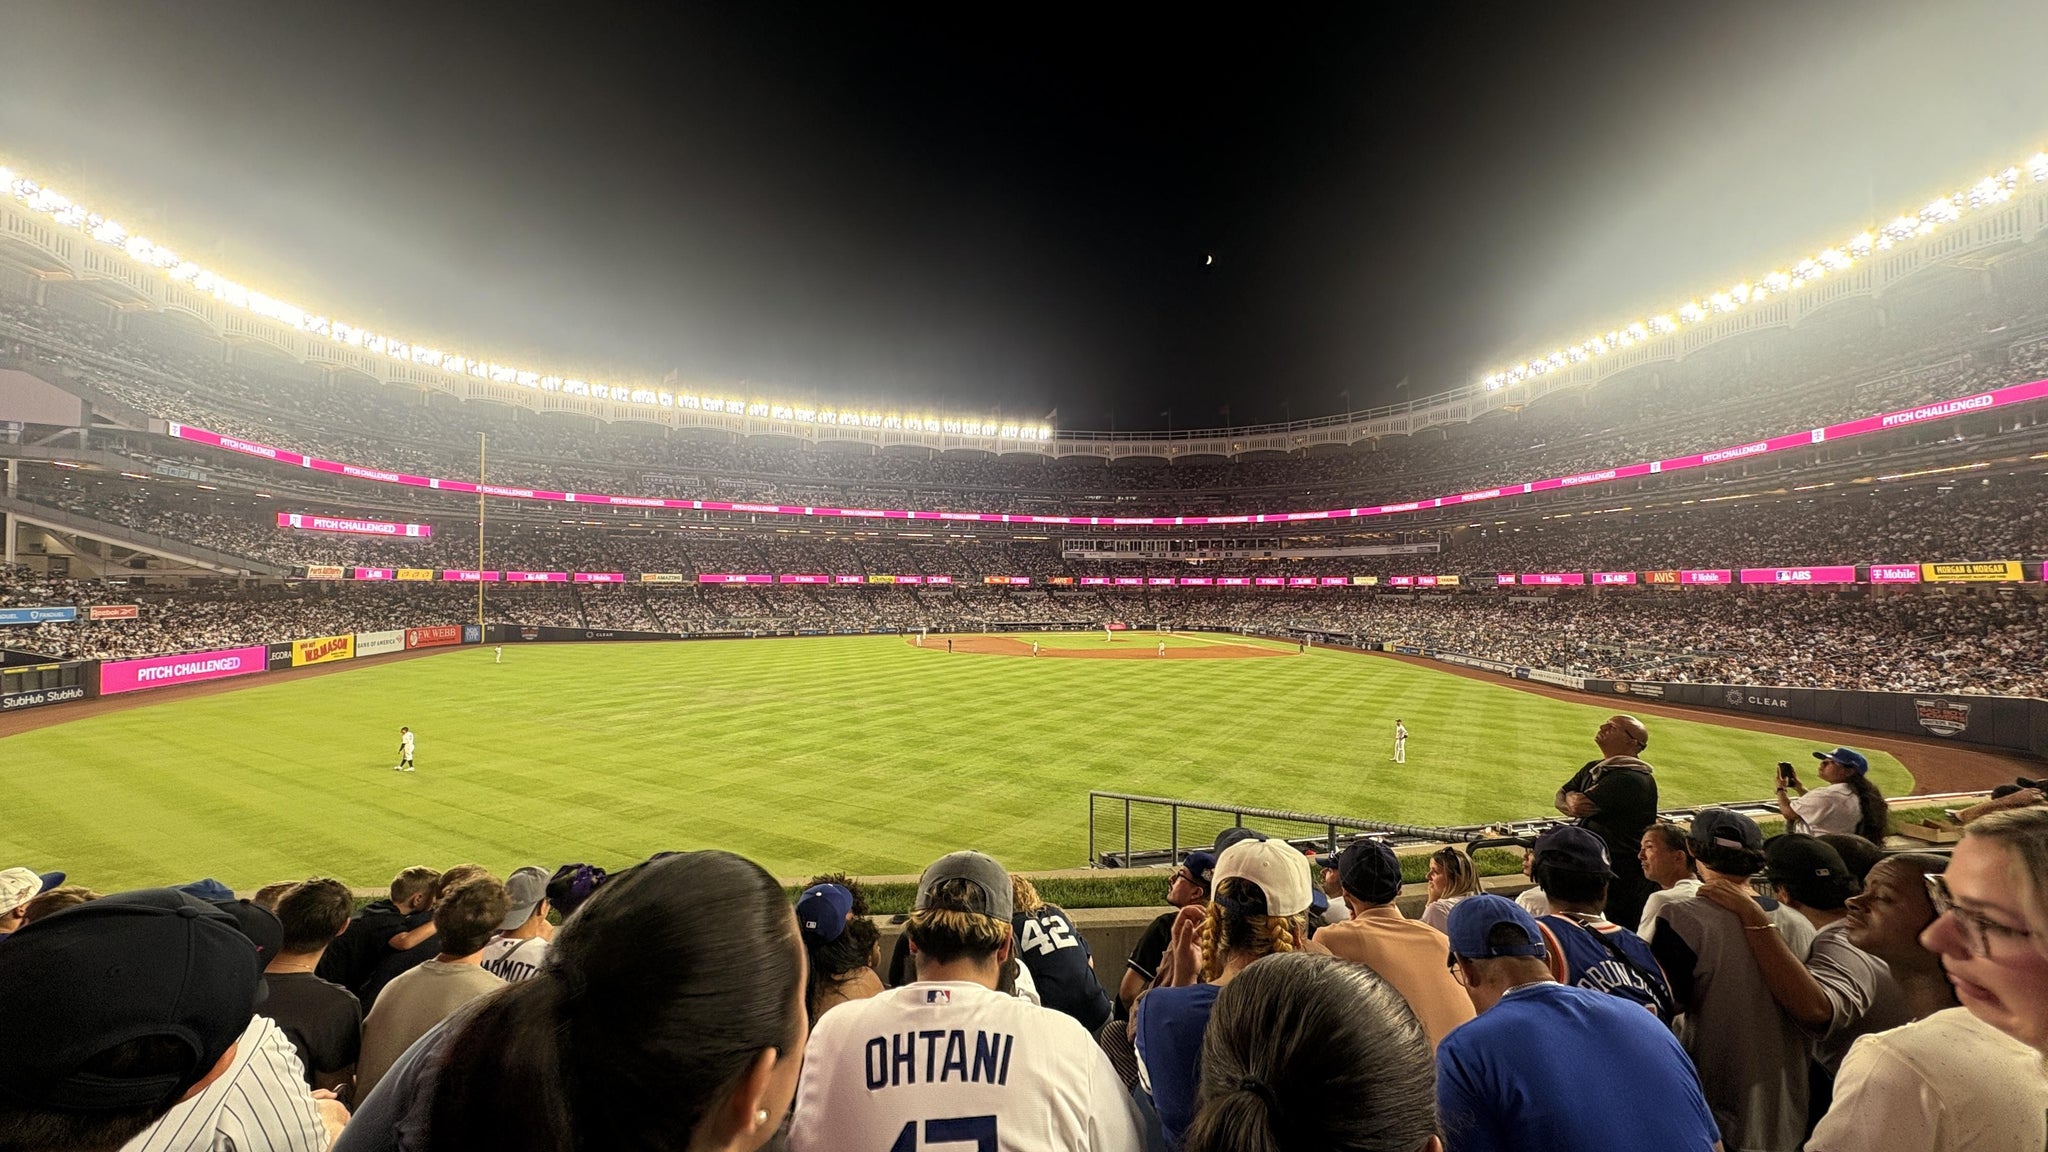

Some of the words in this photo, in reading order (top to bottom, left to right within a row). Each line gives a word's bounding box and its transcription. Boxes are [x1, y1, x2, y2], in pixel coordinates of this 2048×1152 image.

[1883, 411, 1914, 426] PITCH
[1915, 395, 1994, 419] CHALLENGED
[220, 437, 239, 449] PITCH
[239, 442, 276, 458] CHALLENGED
[1703, 453, 1722, 463] PITCH
[1722, 443, 1767, 459] CHALLENGED
[476, 485, 494, 494] PTCH
[314, 519, 339, 528] PITCH
[339, 520, 396, 533] CHALLENGED
[1791, 571, 1811, 580] ABS
[1883, 569, 1916, 579] Mobile
[1936, 566, 1965, 574] MORGAN
[1972, 565, 2004, 573] MORGAN
[1654, 572, 1675, 583] AVIS
[92, 609, 120, 617] Reebok
[432, 628, 456, 638] WEBB
[138, 665, 173, 682] PITCH
[174, 657, 241, 676] CHALLENGED
[3, 694, 44, 708] StubHub
[47, 689, 84, 702] StubHub
[1748, 696, 1787, 708] CLEAR
[1021, 915, 1079, 956] 42
[865, 1029, 1014, 1092] OHTANI
